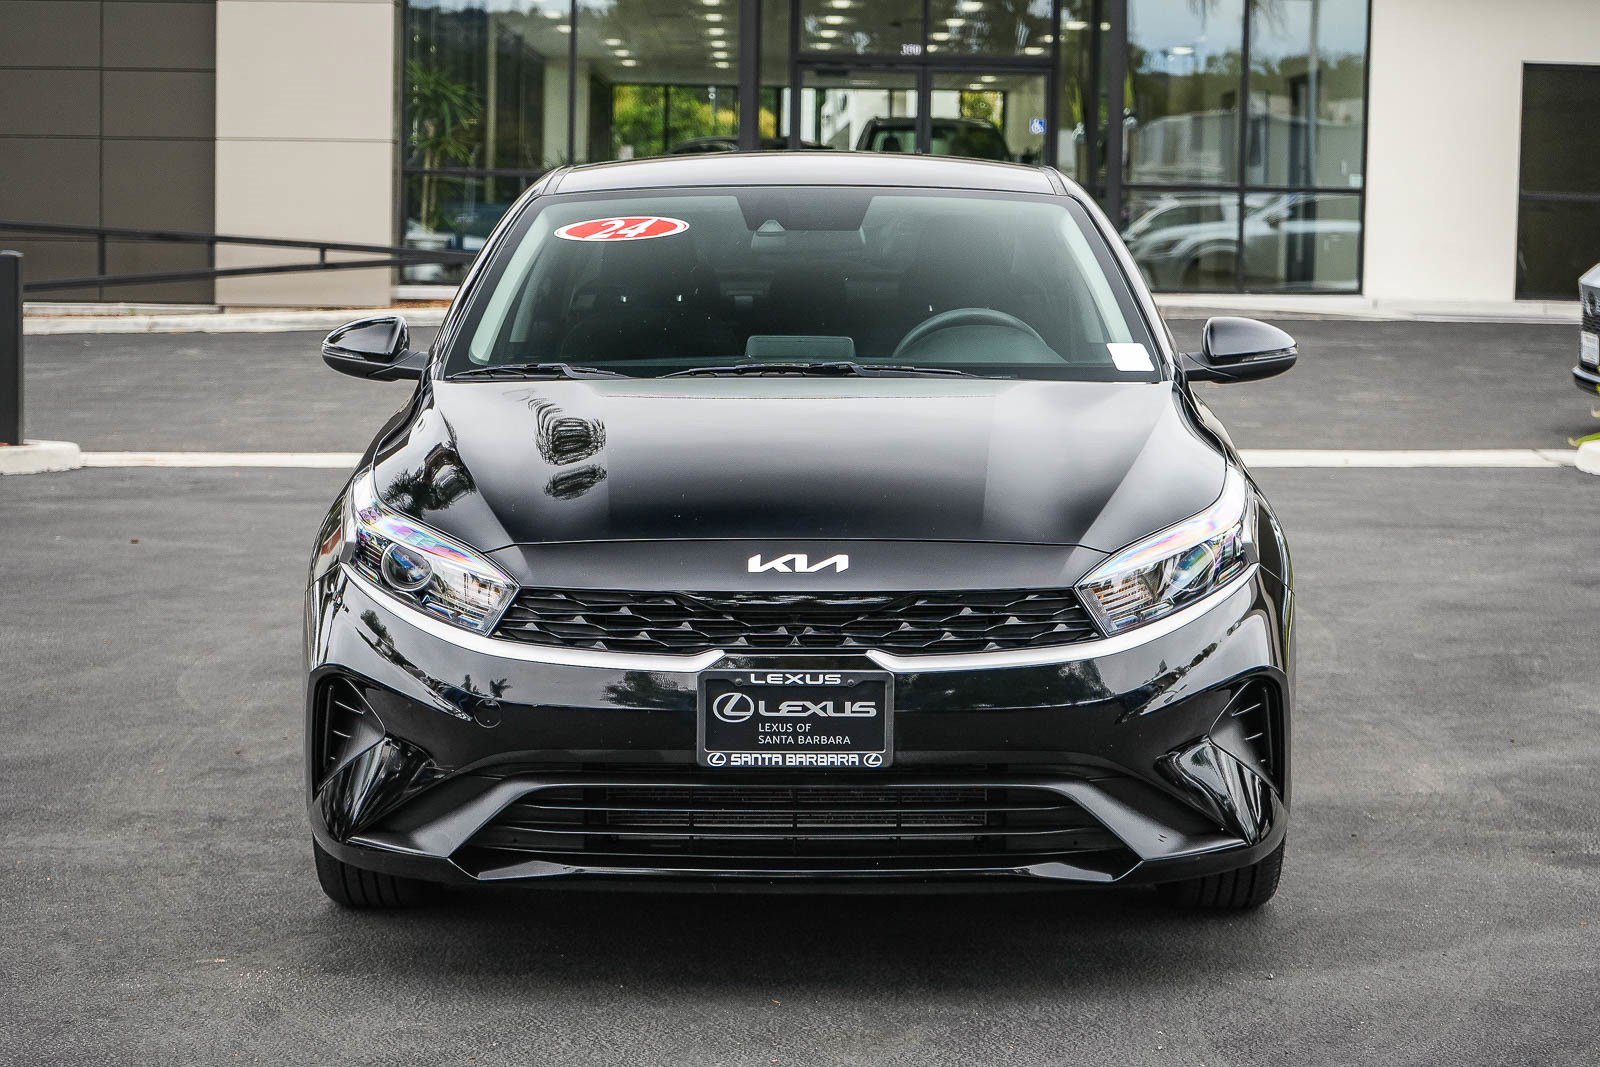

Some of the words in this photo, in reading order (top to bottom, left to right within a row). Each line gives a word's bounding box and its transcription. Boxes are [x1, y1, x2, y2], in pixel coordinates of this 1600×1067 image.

[586, 219, 658, 239] 24
[750, 673, 841, 685] LEXUS
[758, 701, 877, 717] LEXUS
[758, 723, 793, 732] LEXUS
[796, 723, 812, 732] OF
[758, 735, 794, 744] SANTA
[799, 735, 851, 744] BARBARA
[730, 753, 782, 765] SANTA
[785, 753, 860, 766] BARBARA
